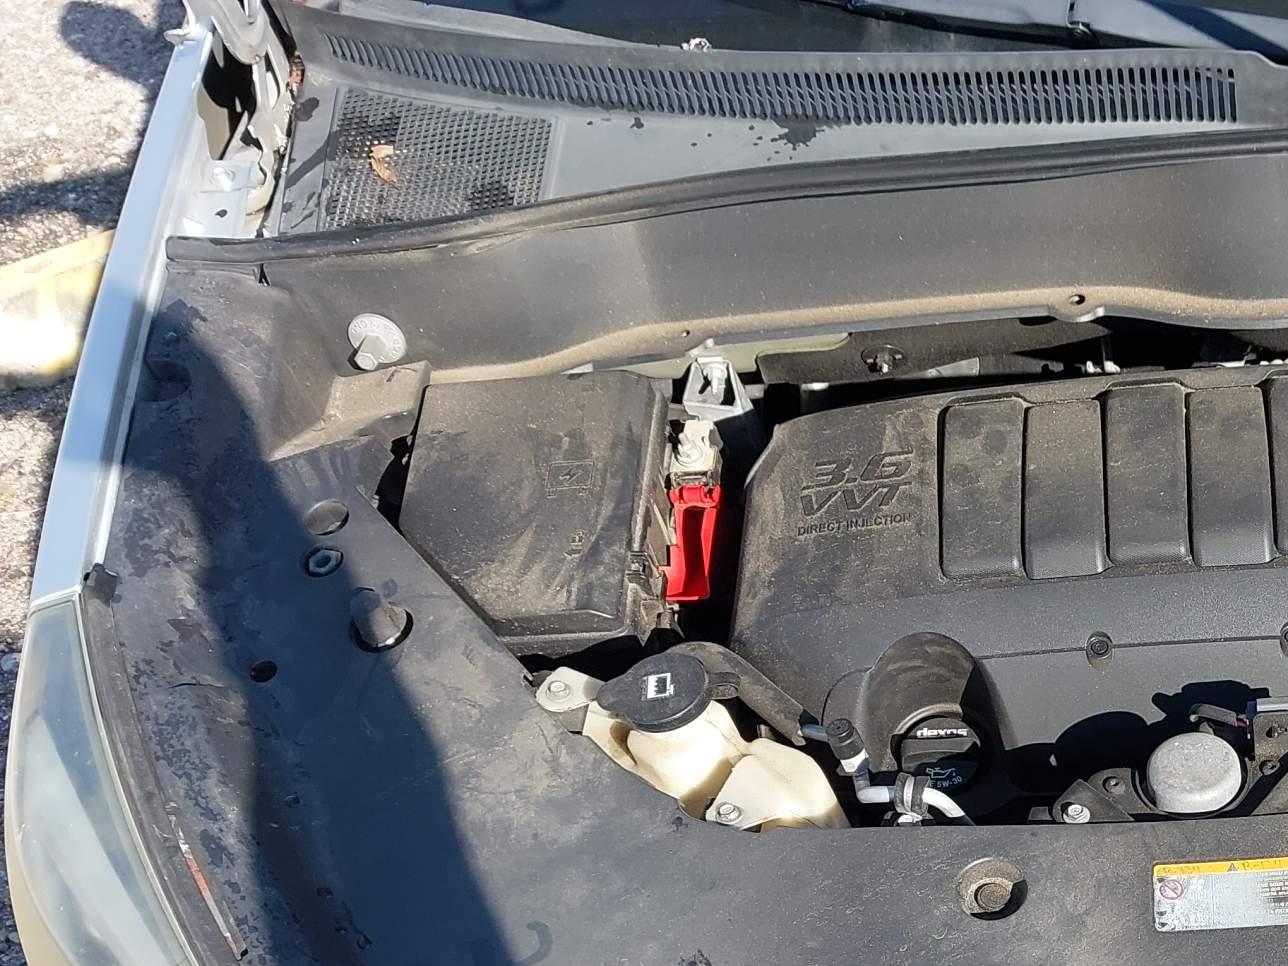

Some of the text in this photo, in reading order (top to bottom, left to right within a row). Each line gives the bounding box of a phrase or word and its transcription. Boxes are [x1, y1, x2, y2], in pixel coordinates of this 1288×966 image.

[801, 449, 914, 490] 3.6
[800, 481, 912, 518] VVT
[798, 513, 911, 537] DIRECT INJECTION
